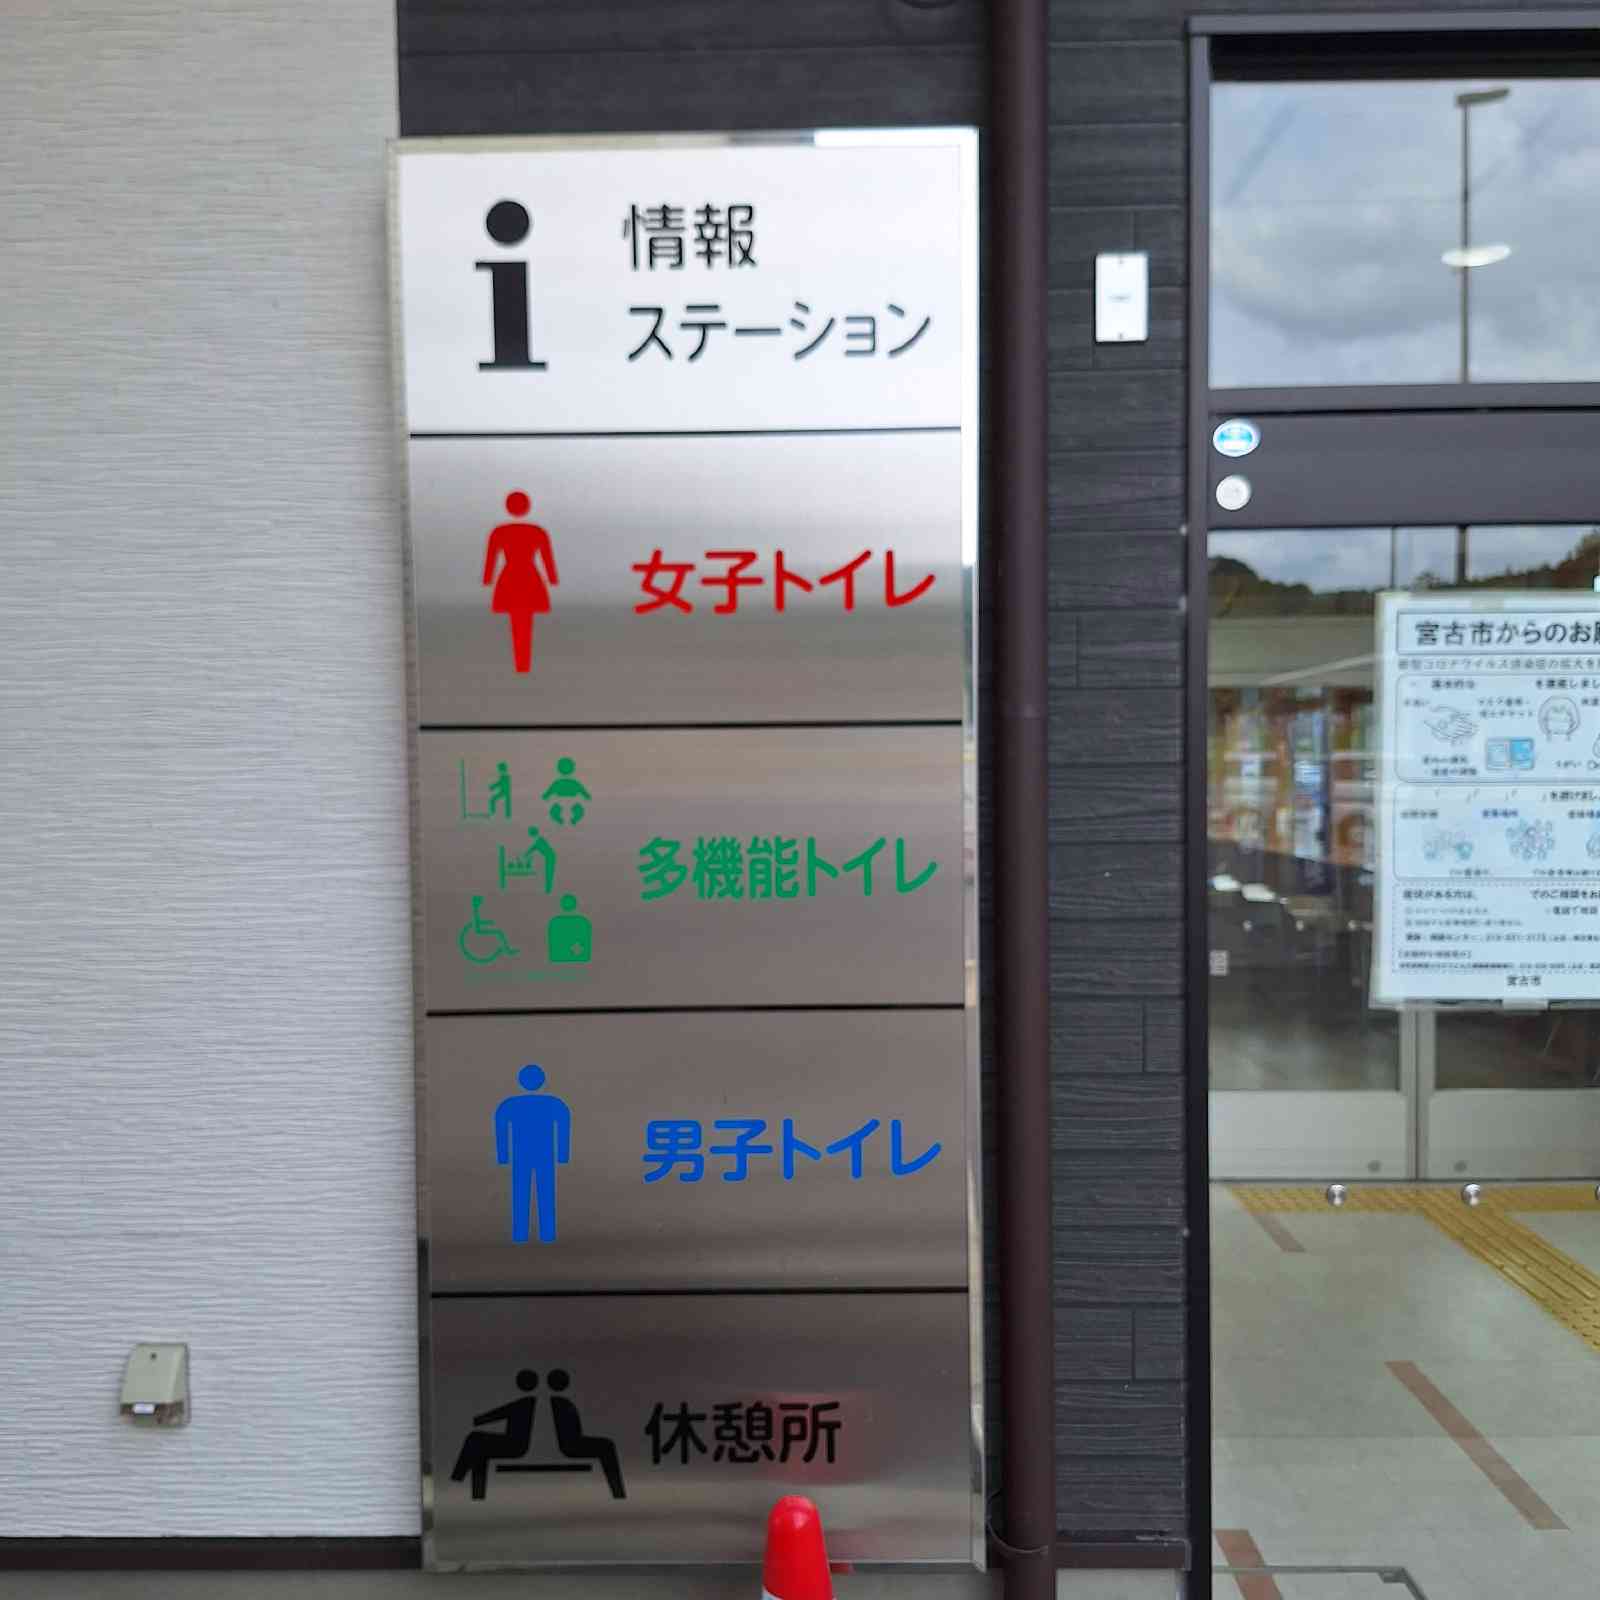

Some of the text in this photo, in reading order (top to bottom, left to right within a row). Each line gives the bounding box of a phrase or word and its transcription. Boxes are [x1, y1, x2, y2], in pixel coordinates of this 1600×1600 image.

[623, 203, 757, 272] 情報
[627, 301, 932, 362] ステーション
[631, 549, 935, 615] 女子トイレ
[1415, 621, 1600, 645] 宮古市からのお
[638, 834, 939, 902] 多機能トイレ
[641, 1119, 941, 1184] 男子トイレ
[644, 1401, 841, 1465] 休憩所
